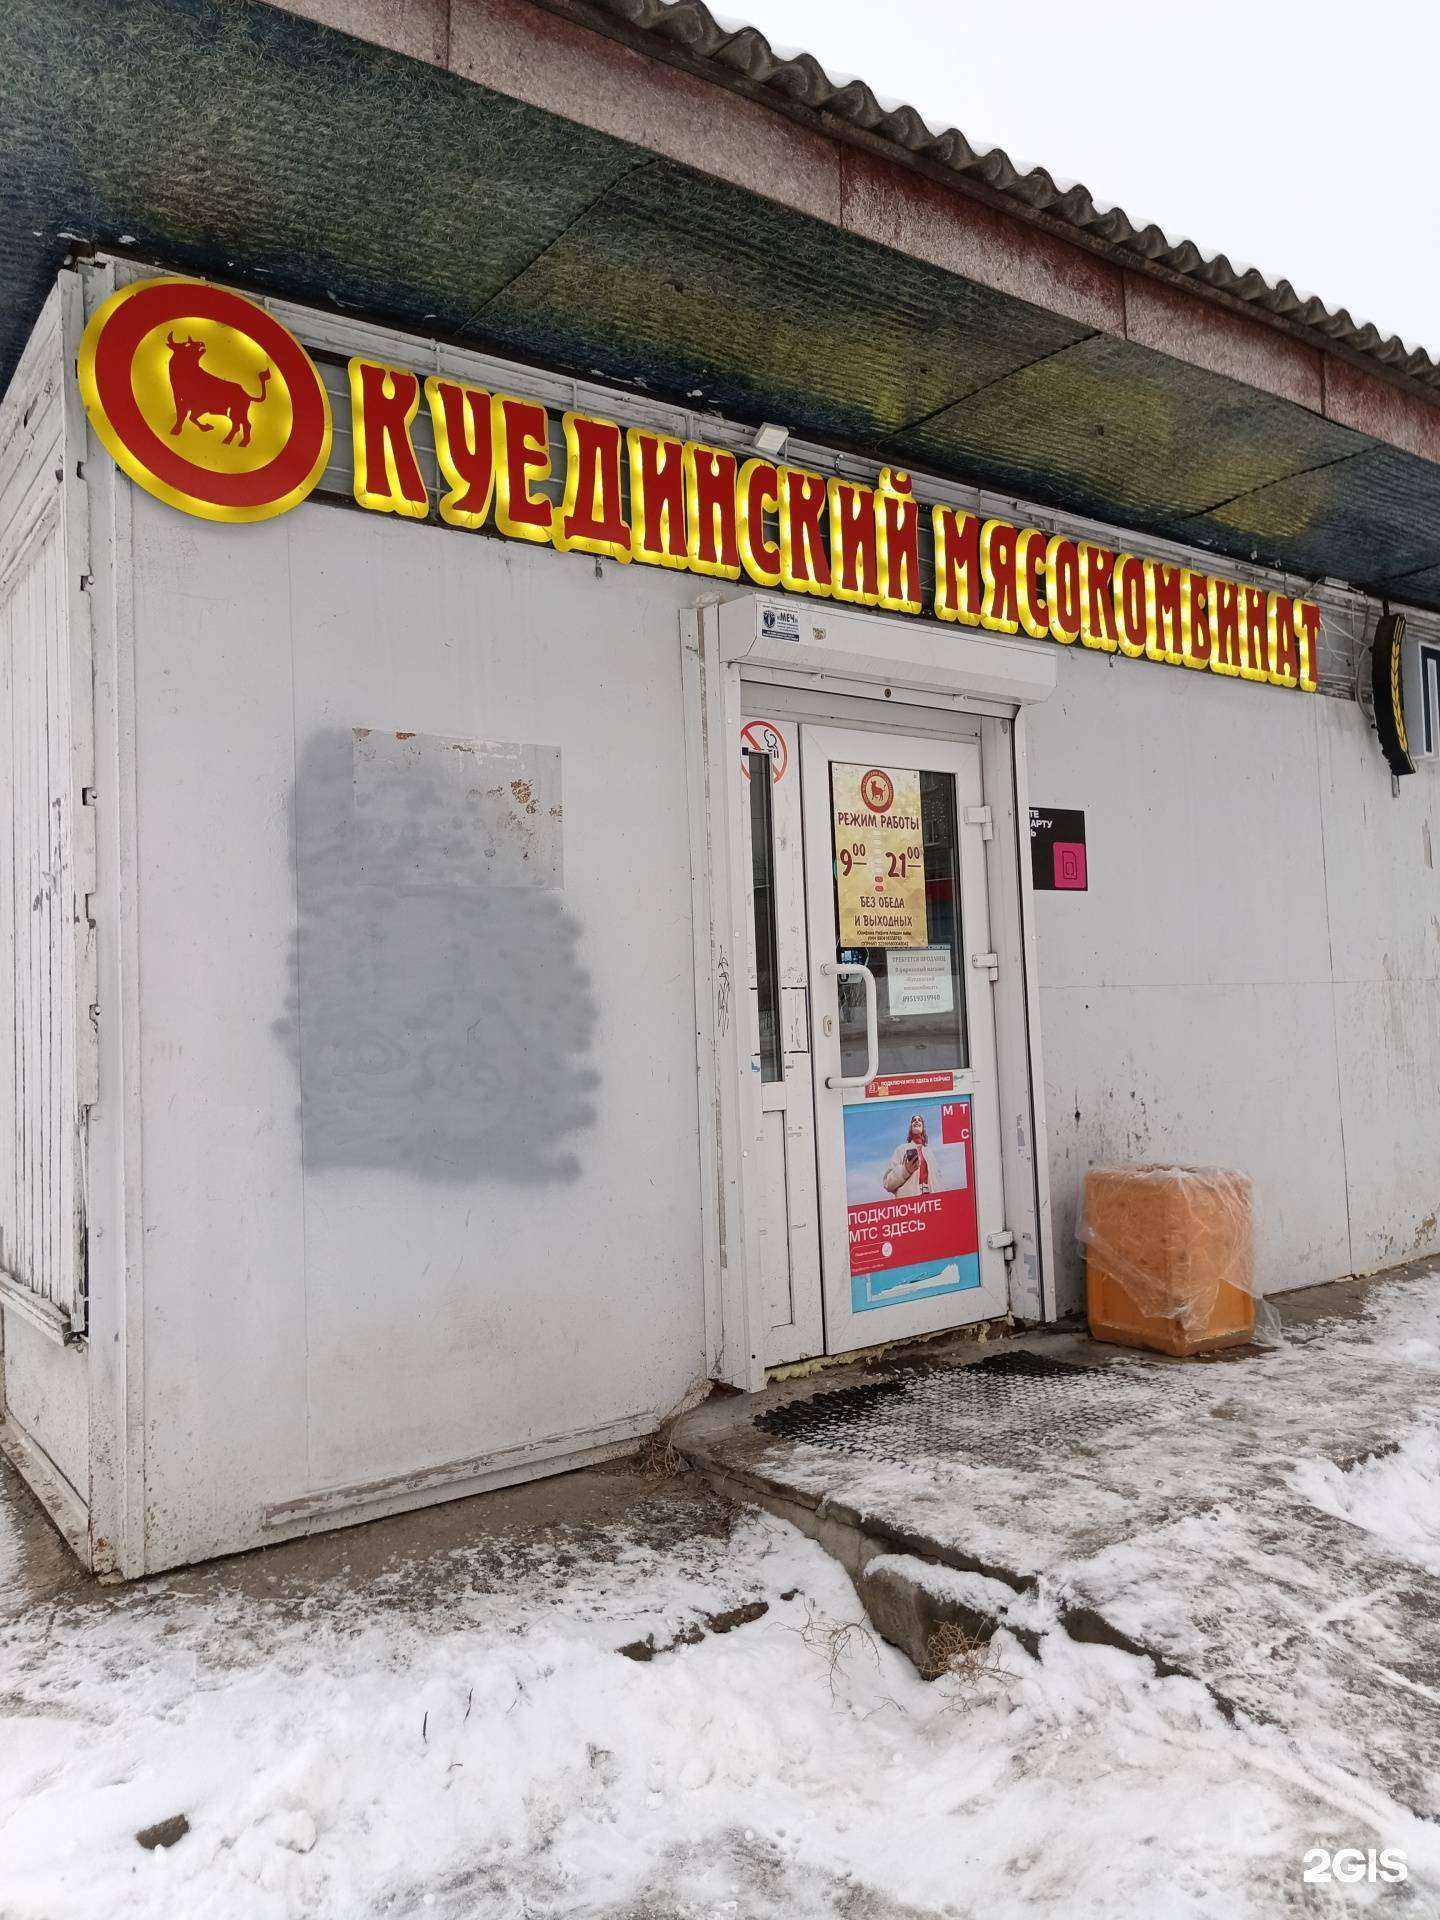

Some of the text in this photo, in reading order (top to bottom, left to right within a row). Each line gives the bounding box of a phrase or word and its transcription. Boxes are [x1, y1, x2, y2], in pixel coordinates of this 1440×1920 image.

[349, 357, 1320, 692] КУЕДИНСКИЙ МЯСОКОМБИНАТ
[838, 812, 920, 830] РЕЖИМ РАБОТЫ
[860, 896, 905, 909] БЕЗ ОБЕДА
[854, 915, 913, 927] И ВЫХОДНЫХ
[848, 1198, 942, 1226] ПОДКЛЮЧИТЕ
[849, 1219, 926, 1244] МТС ЗДЕСЬ
